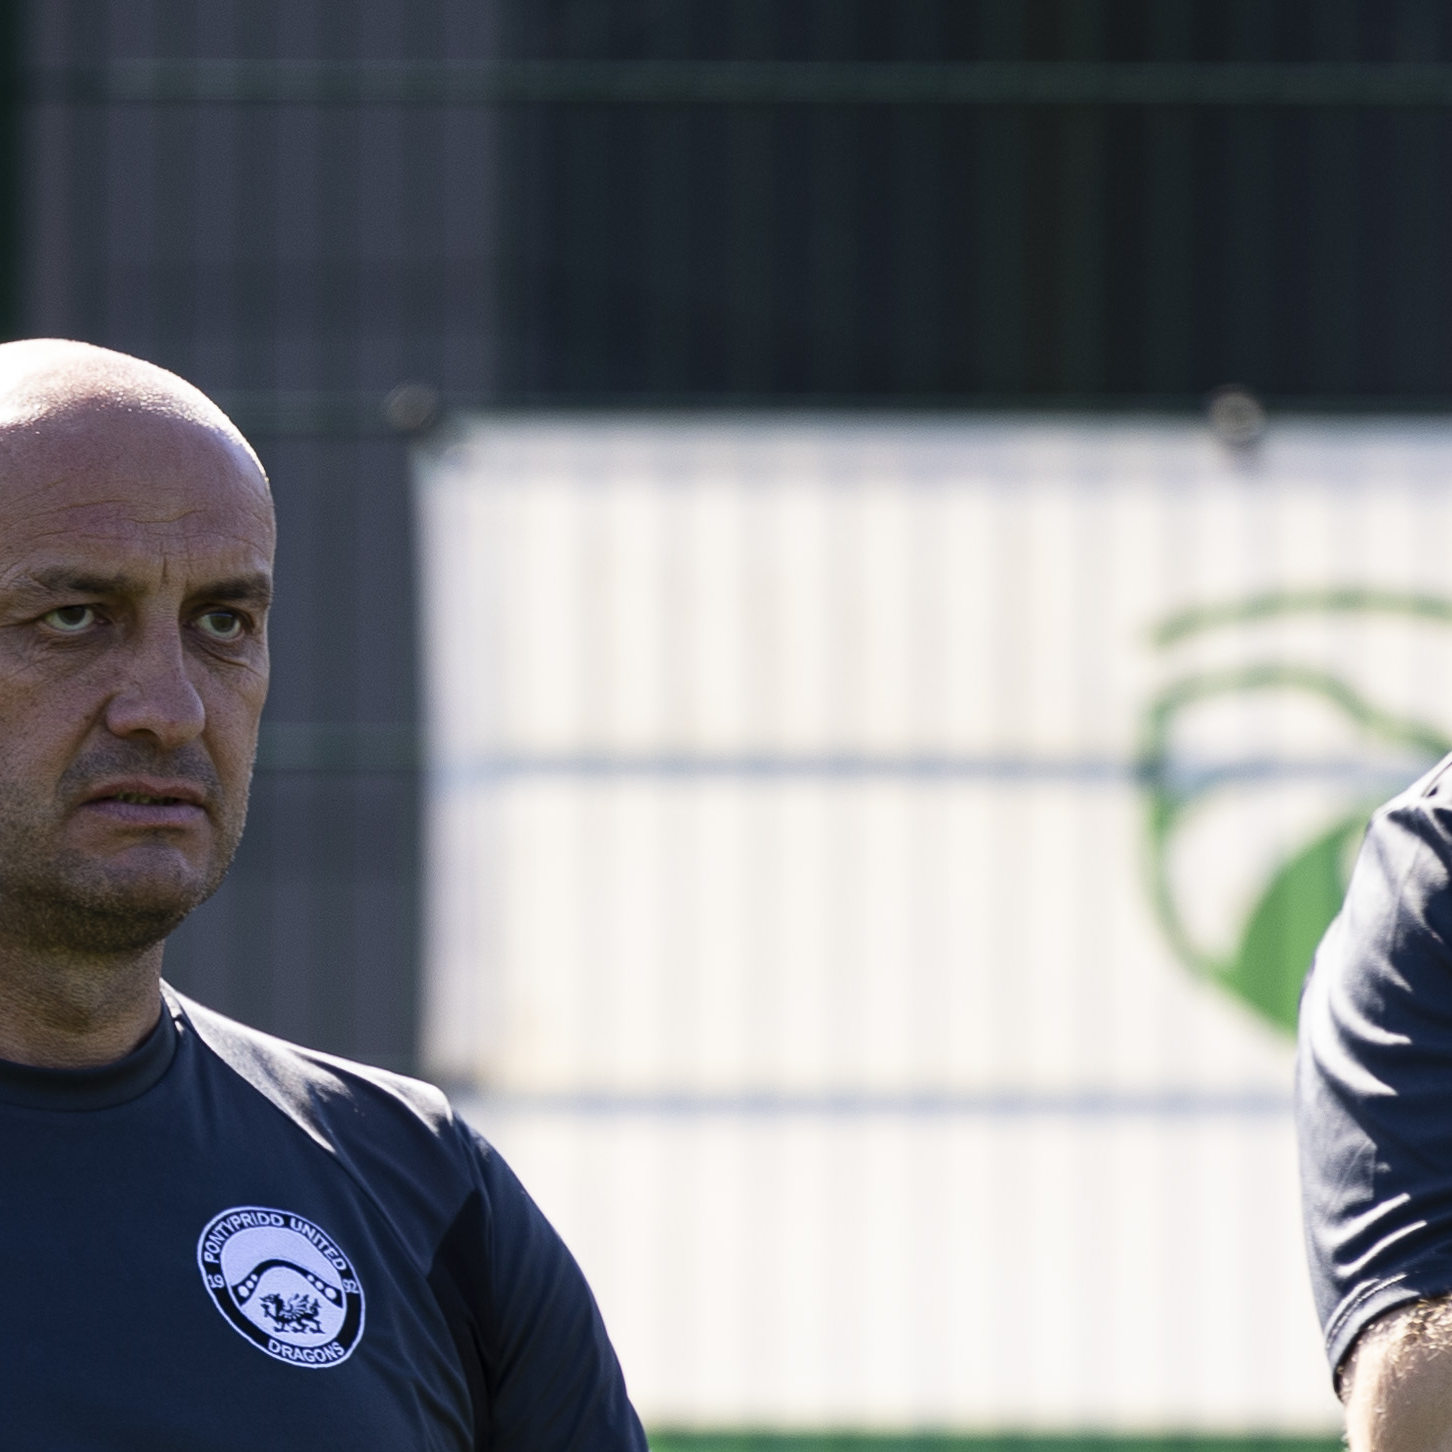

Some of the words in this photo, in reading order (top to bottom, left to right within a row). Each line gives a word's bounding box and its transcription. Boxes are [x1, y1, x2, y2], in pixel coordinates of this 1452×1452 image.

[203, 1212, 285, 1263] PONTYPRIDD
[289, 1217, 348, 1271] UNITED
[207, 1274, 225, 1288] 19
[342, 1279, 360, 1294] 92
[267, 1338, 345, 1363] DRAGONS
